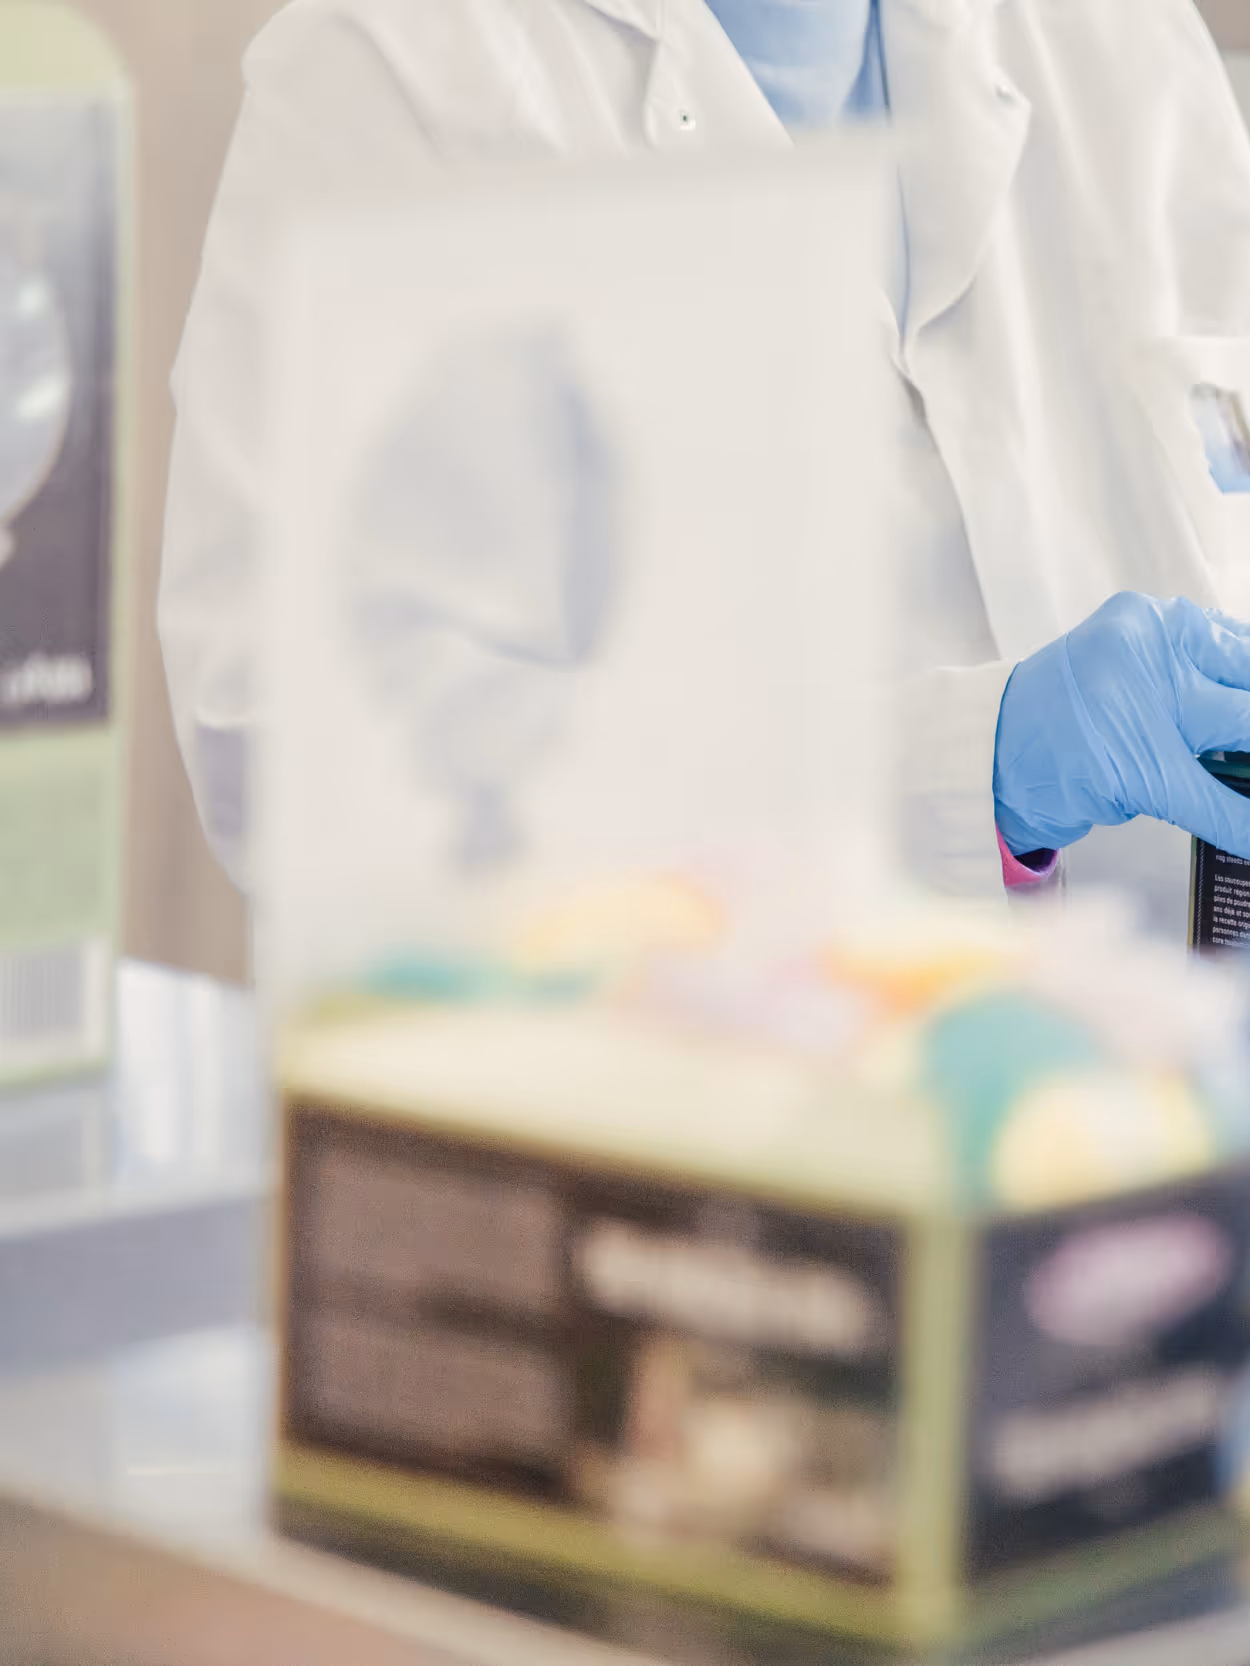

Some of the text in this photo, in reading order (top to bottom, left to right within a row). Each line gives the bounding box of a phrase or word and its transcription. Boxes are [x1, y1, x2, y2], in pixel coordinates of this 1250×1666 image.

[1216, 855, 1226, 863] nog
[1214, 874, 1224, 882] Les
[1214, 885, 1233, 894] produit
